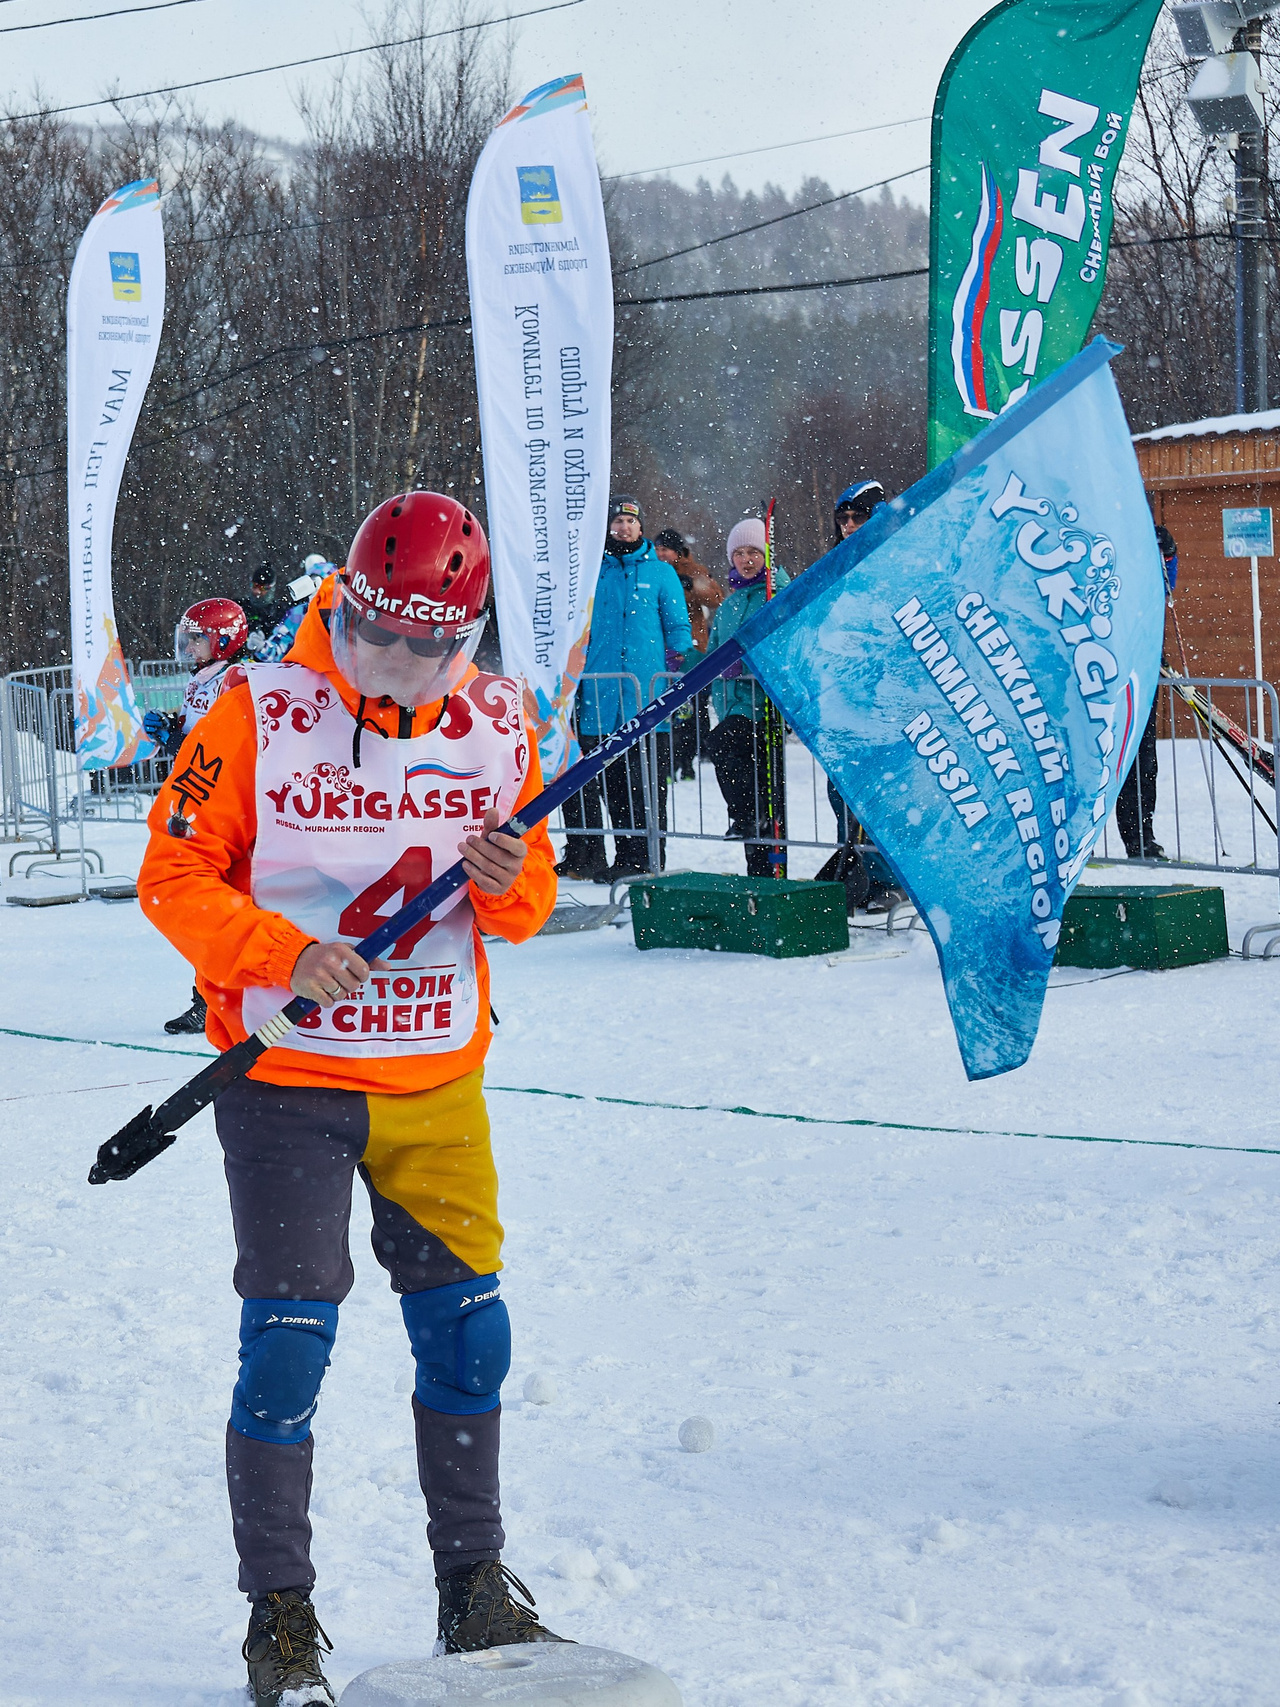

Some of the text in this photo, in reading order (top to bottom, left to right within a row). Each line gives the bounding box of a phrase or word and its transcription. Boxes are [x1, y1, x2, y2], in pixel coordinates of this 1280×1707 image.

[1079, 112, 1123, 283] СНЕЖНЫЙ БОЙ
[955, 591, 1069, 785] СНЕЖНЫЙ
[275, 818, 303, 832] RUSSIA,
[892, 595, 1062, 950] MURMANSK REGION
[901, 709, 991, 830] RUSSIA
[338, 846, 440, 960] 4
[332, 1001, 452, 1033] СНЕГЕ
[371, 974, 455, 999] ТОЛК
